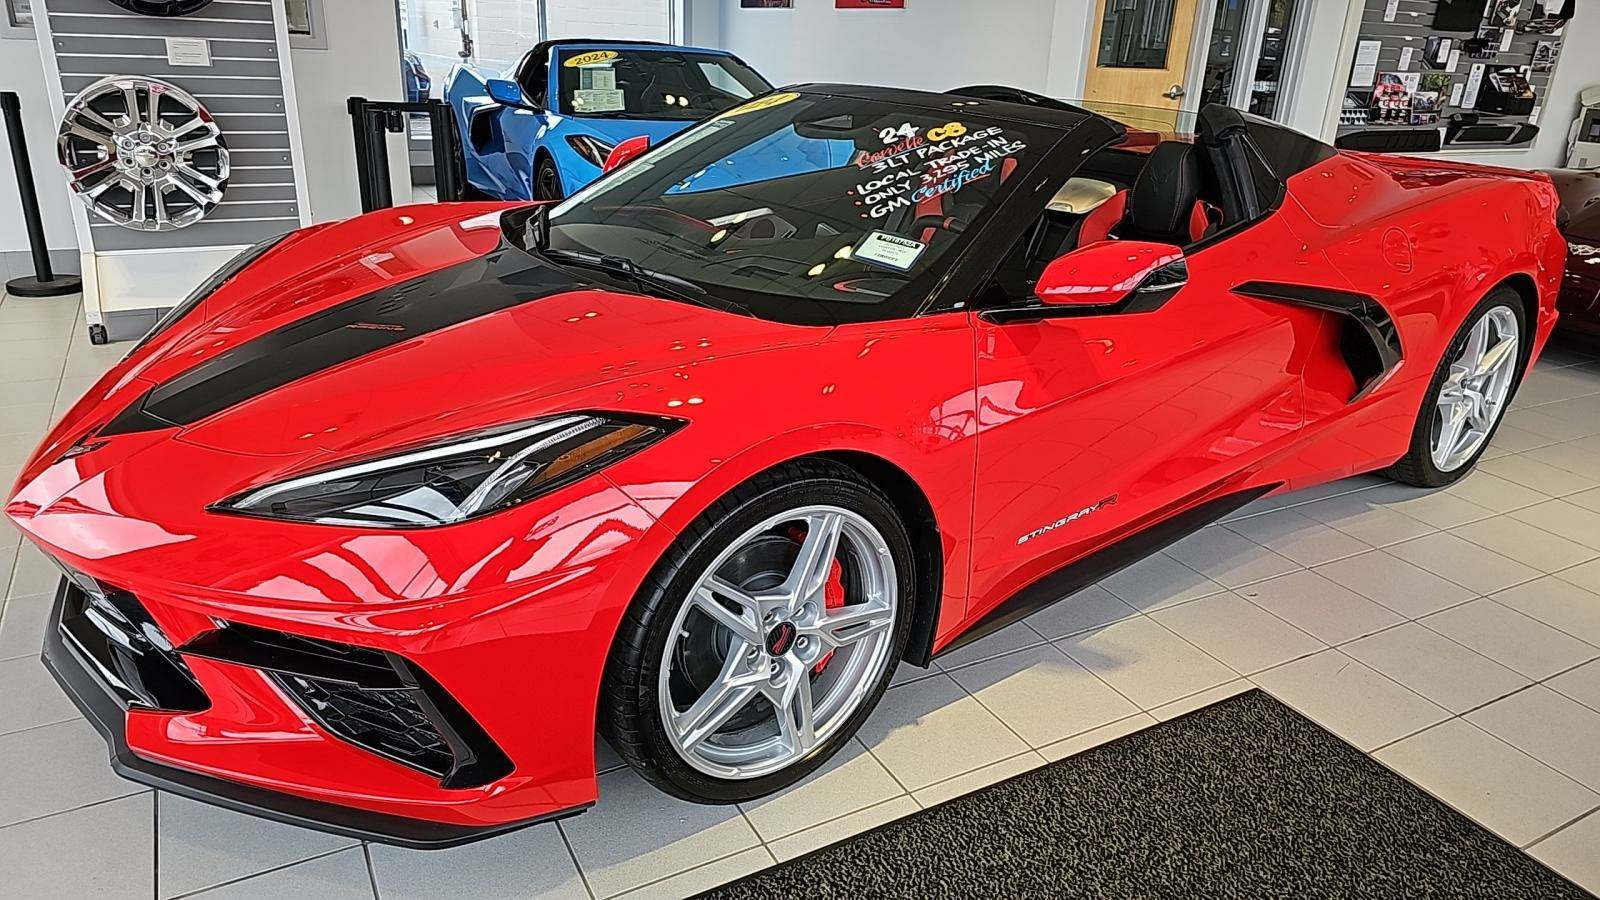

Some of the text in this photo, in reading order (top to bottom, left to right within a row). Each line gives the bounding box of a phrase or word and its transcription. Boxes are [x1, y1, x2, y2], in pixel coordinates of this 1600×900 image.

[574, 52, 608, 65] 2024
[871, 126, 1004, 174] 3LT PACKAGE
[926, 121, 968, 142] C8
[856, 136, 1009, 195] LOCAL TRADE-IN
[864, 142, 1027, 205] ONLY 3,295 MILES
[869, 160, 996, 219] GM Certified
[1017, 502, 1100, 545] STINGRAY
